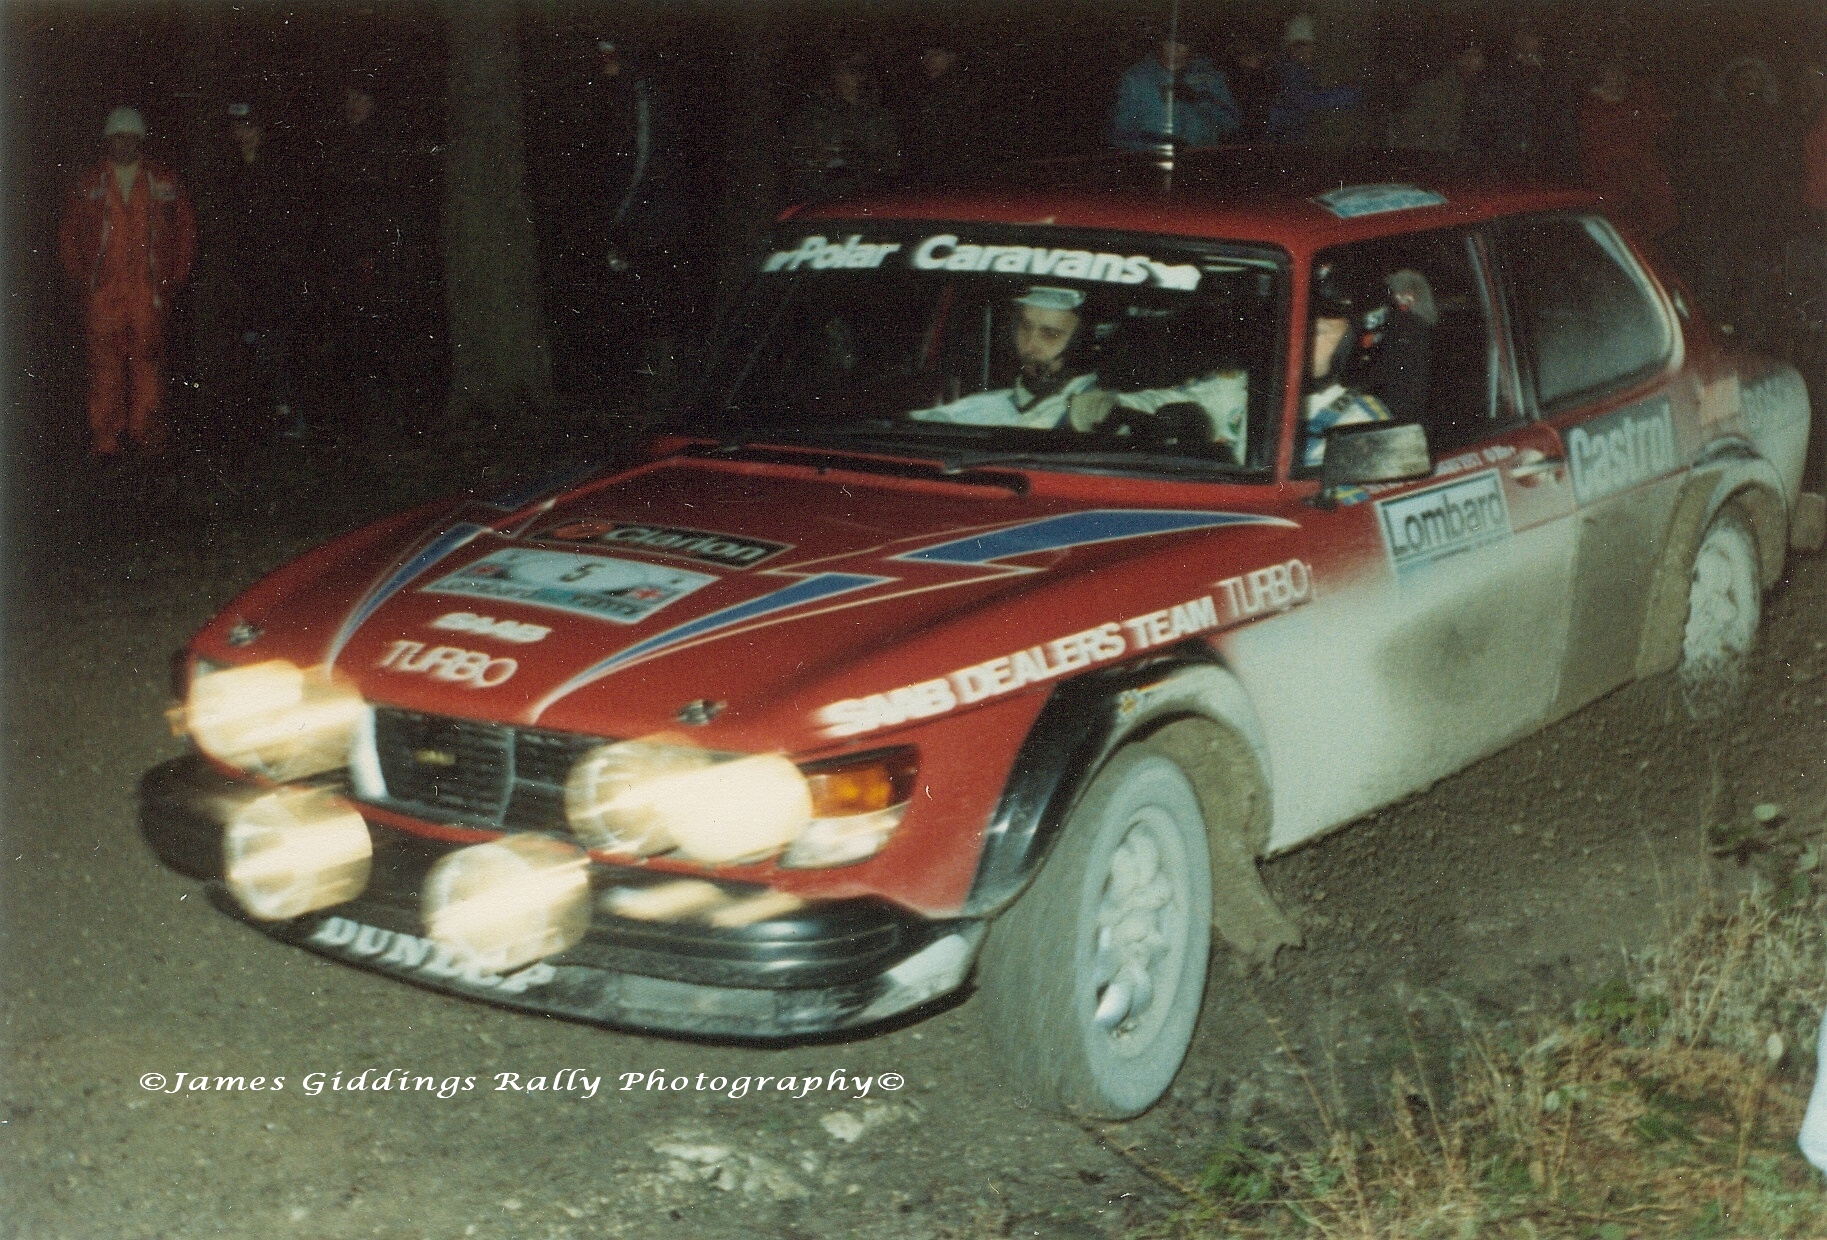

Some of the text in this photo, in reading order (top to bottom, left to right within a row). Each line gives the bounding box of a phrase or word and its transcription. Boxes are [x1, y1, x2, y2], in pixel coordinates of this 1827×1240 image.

[912, 234, 1152, 284] Caravans
[1382, 480, 1504, 556] Lombard
[604, 528, 766, 562] Clarion
[953, 622, 1126, 706] DEALERS
[1122, 595, 1219, 649] TEAM
[1213, 558, 1313, 613] TURBO
[377, 639, 518, 689] TURBO
